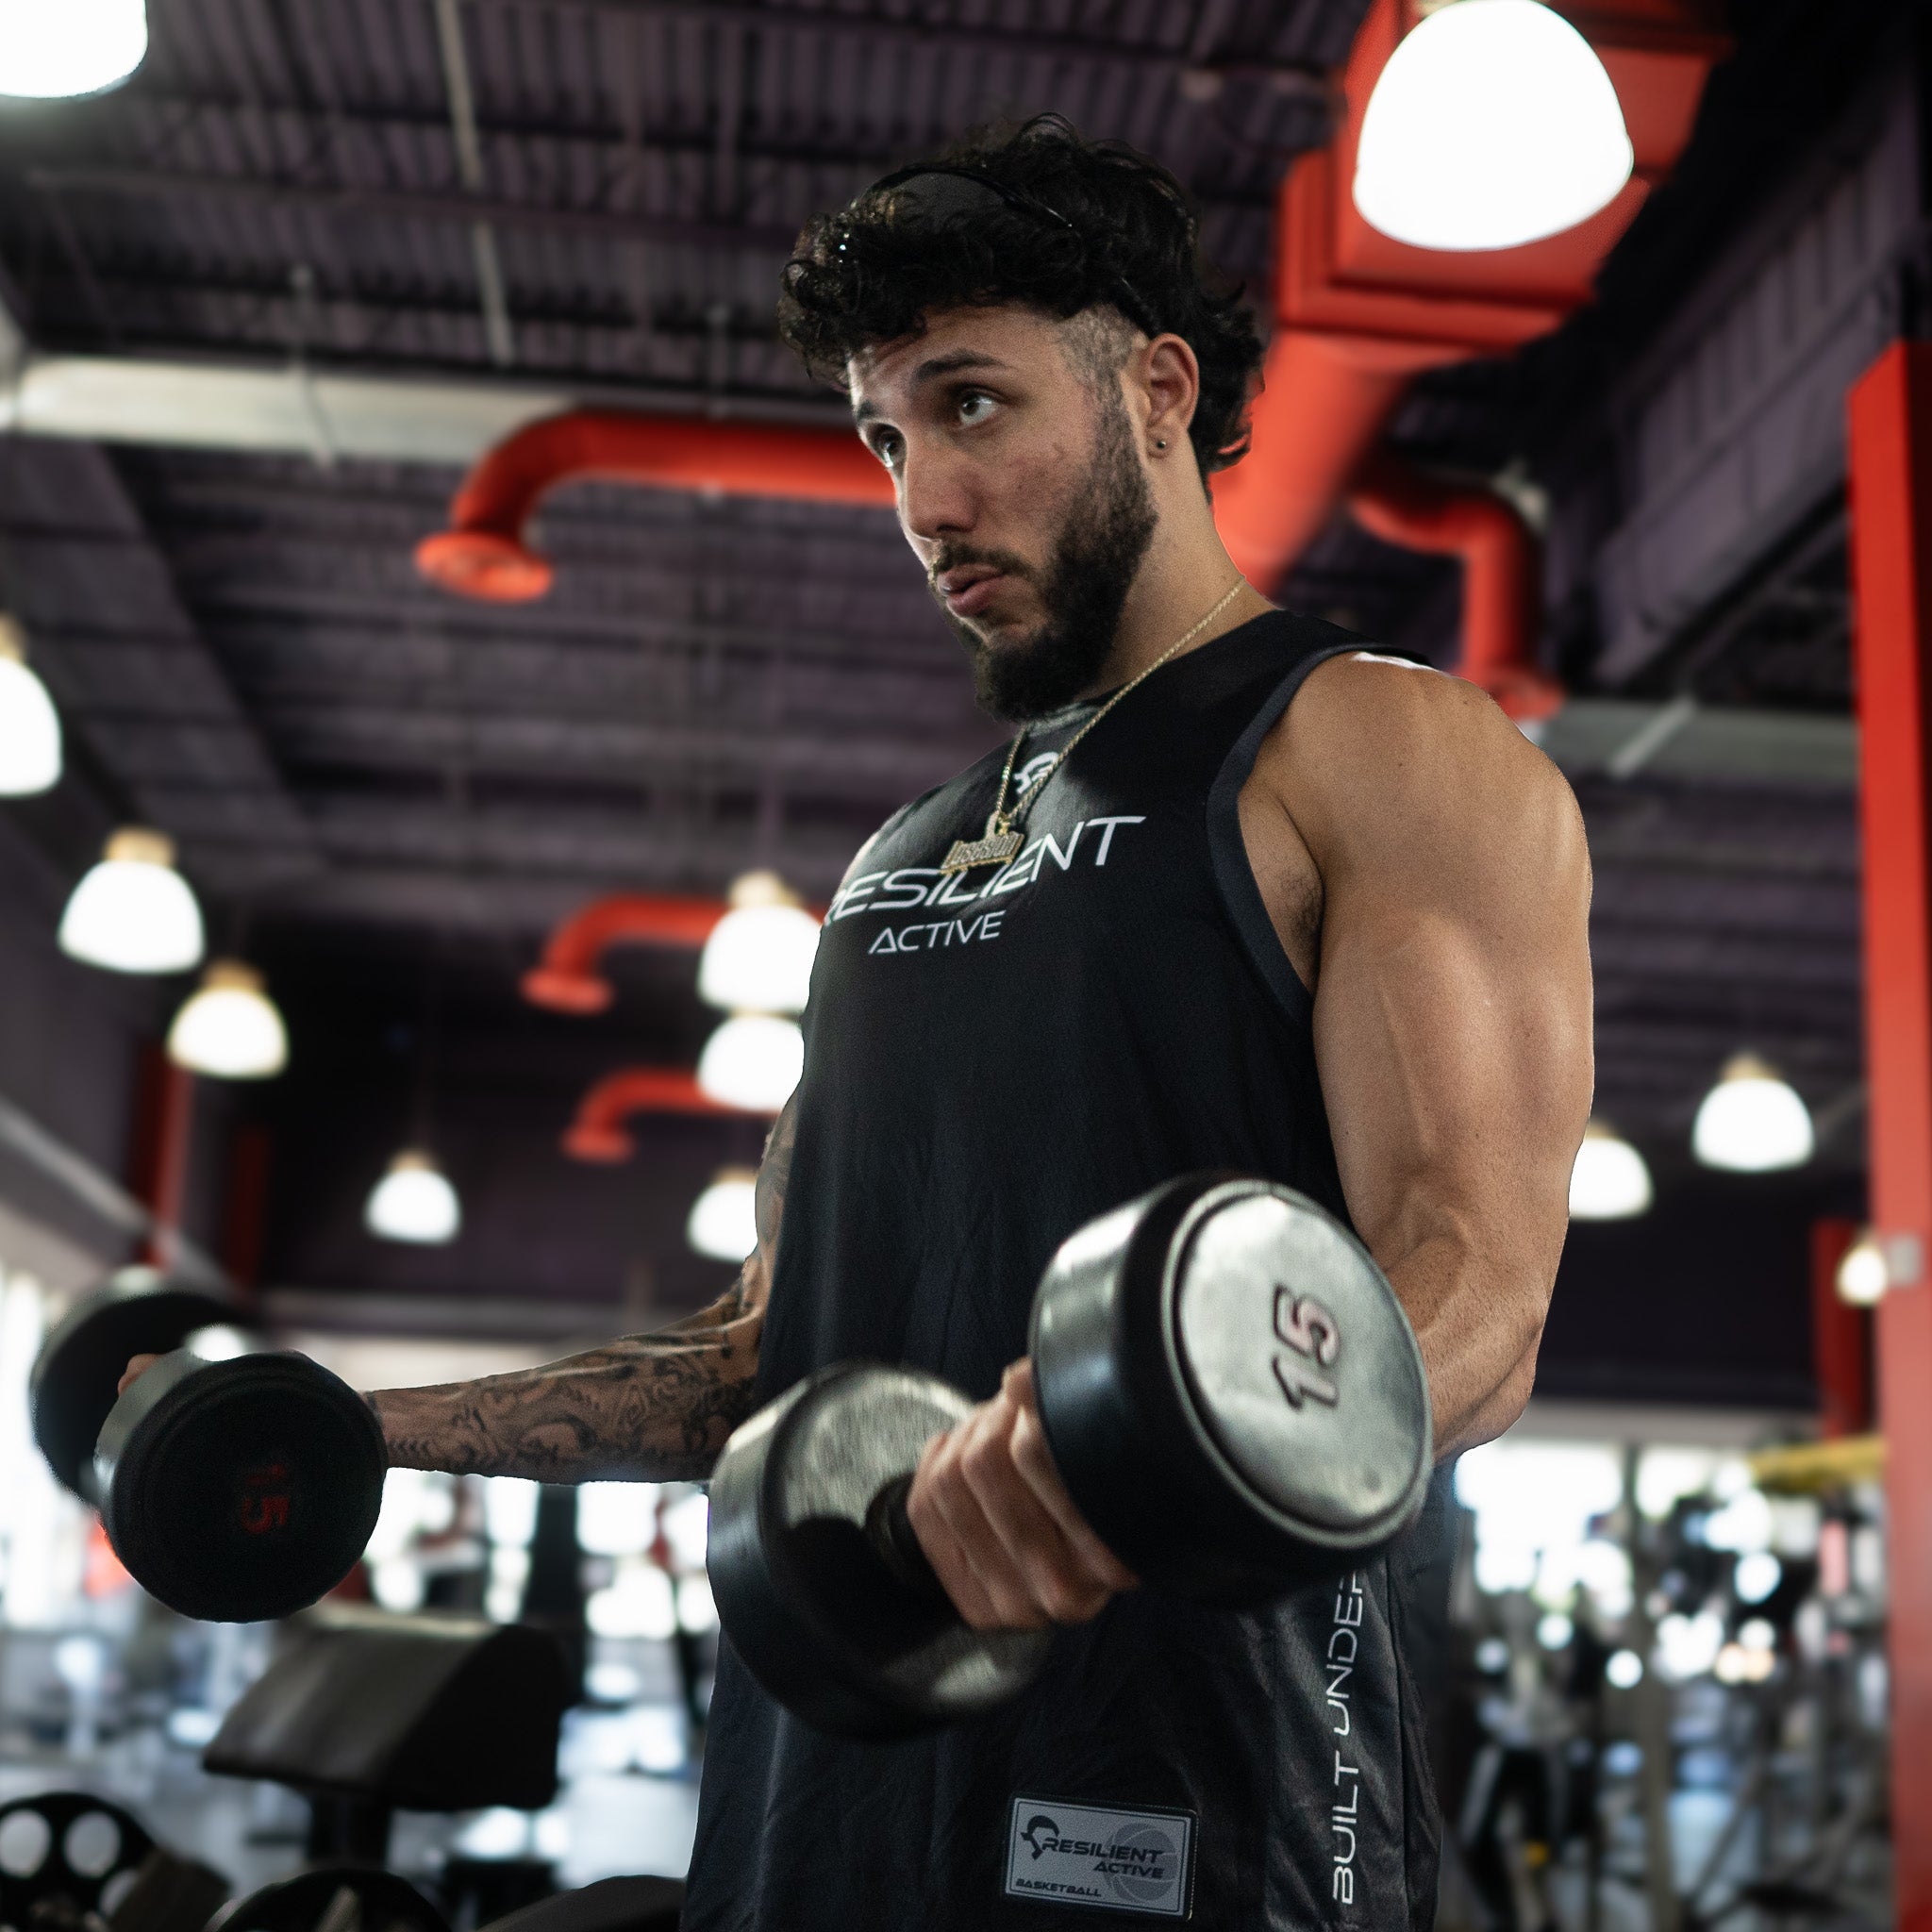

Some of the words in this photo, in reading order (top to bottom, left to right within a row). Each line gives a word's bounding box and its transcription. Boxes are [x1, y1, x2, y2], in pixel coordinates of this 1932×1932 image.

[868, 909, 1007, 955] ACTIVE
[1272, 1283, 1341, 1411] 15
[241, 1461, 291, 1535] 15
[1041, 1837, 1163, 1864] RESILIENT
[1332, 1750, 1359, 1906] BUILT
[1015, 1877, 1102, 1897] BASKETBALL
[1092, 1860, 1165, 1879] ACTIVE
